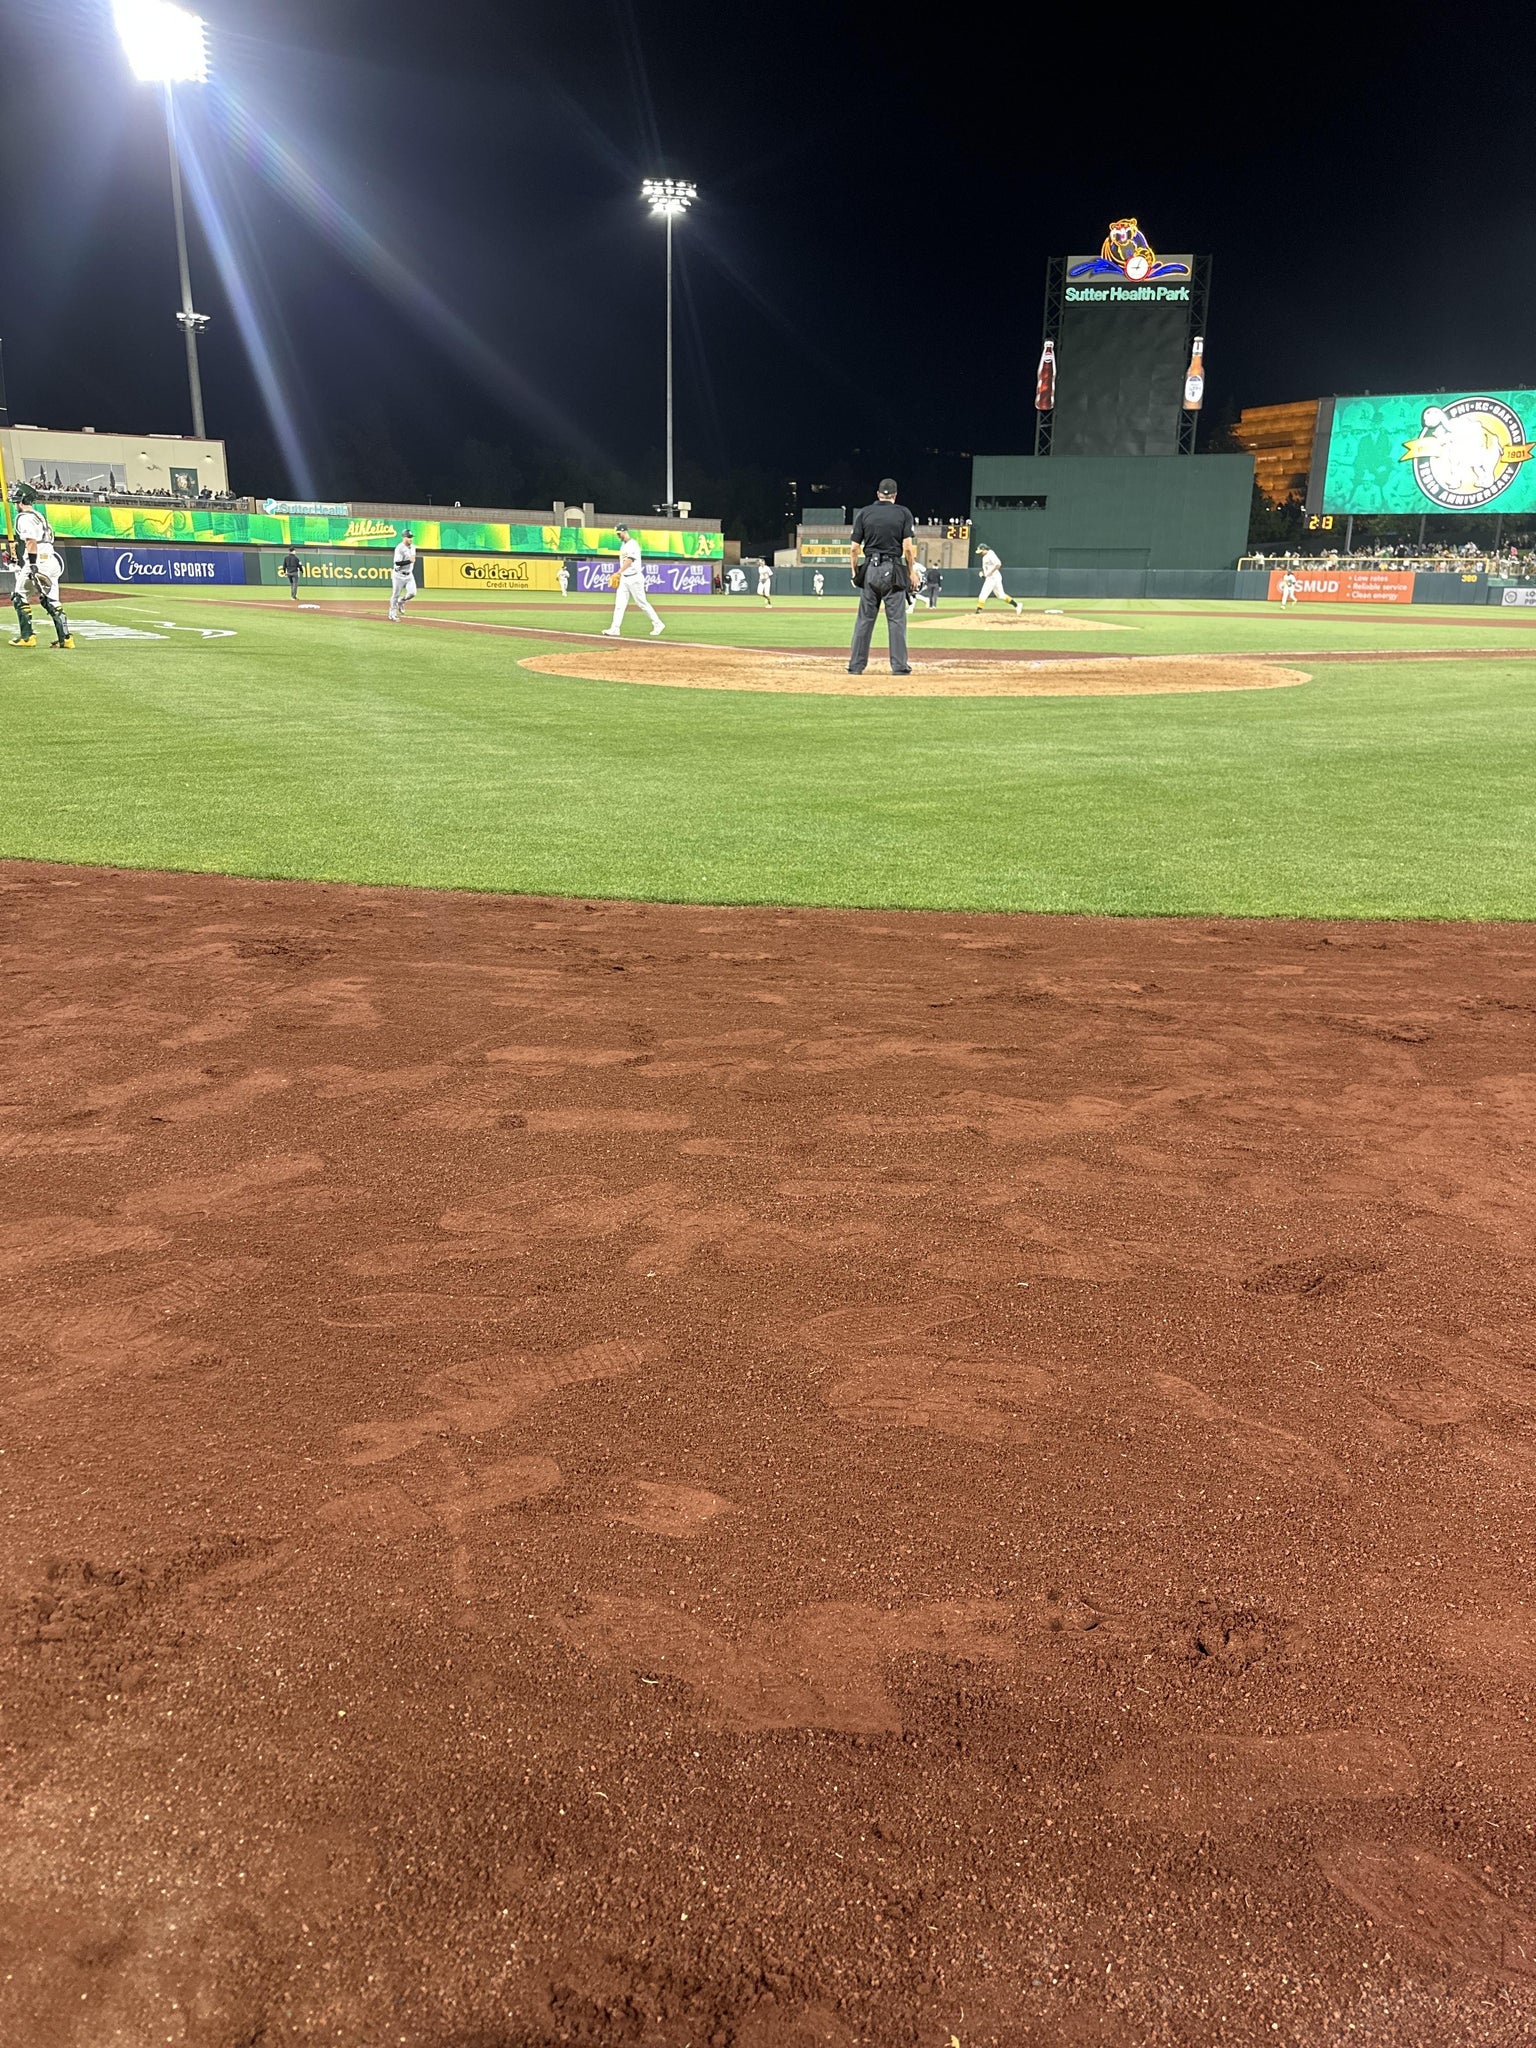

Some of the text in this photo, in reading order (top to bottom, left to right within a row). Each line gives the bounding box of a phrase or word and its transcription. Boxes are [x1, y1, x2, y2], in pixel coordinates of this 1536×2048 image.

[1065, 286, 1190, 301] Sutter Health Park
[1507, 449, 1526, 459] 1901
[1438, 465, 1515, 505] ANNIVERSARY
[279, 502, 349, 516] Sutter Health
[344, 520, 397, 539] Athletics
[115, 552, 216, 580] Circa SPORTS
[277, 562, 393, 580] ahletics.com
[578, 565, 611, 591] Veg
[667, 566, 710, 592] Vegas
[1294, 580, 1339, 593] SMUD
